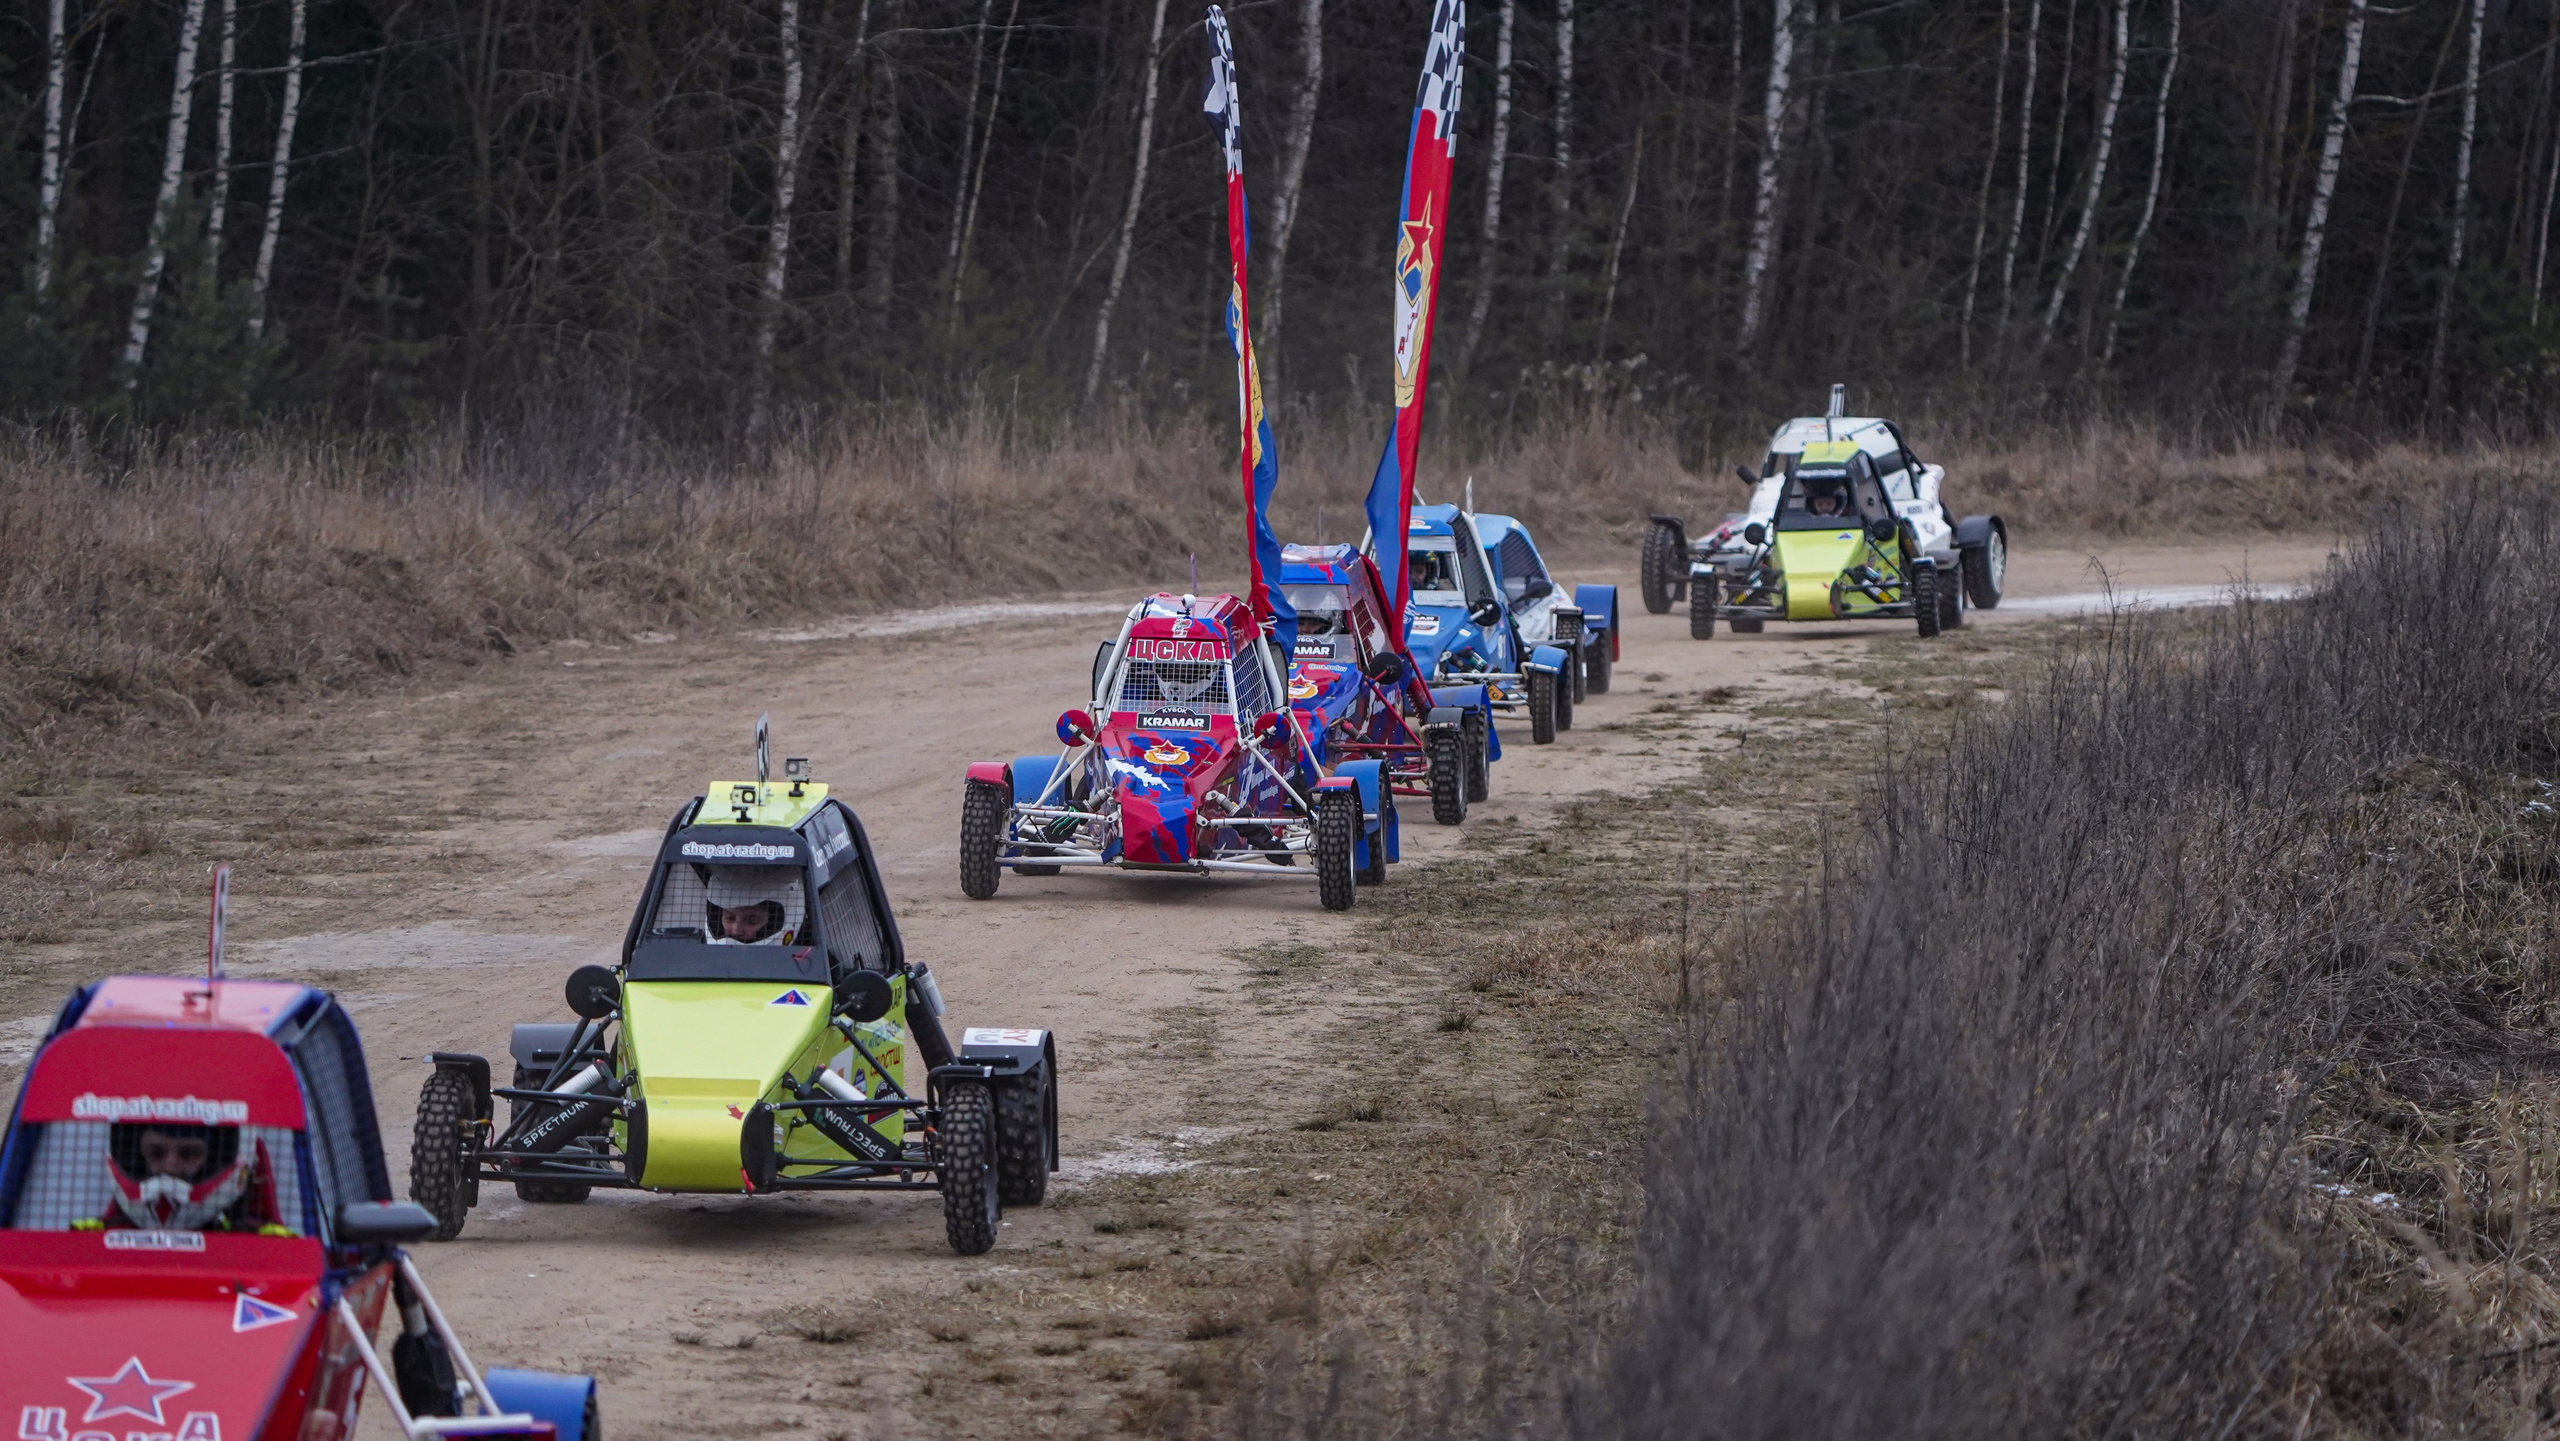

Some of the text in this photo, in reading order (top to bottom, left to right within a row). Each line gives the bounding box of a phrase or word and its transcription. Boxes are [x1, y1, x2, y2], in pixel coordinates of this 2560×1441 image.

[1135, 639, 1216, 662] ЦСКА
[1293, 646, 1330, 655] AMAR
[1295, 636, 1315, 644] УБОК
[1143, 716, 1205, 728] KRAMAR
[682, 841, 795, 860] shop.at-racing.ru
[72, 1092, 248, 1125] shop.at-racing.ru
[522, 1100, 589, 1148] SPECTRUM
[825, 1107, 887, 1158] SPECTRUM
